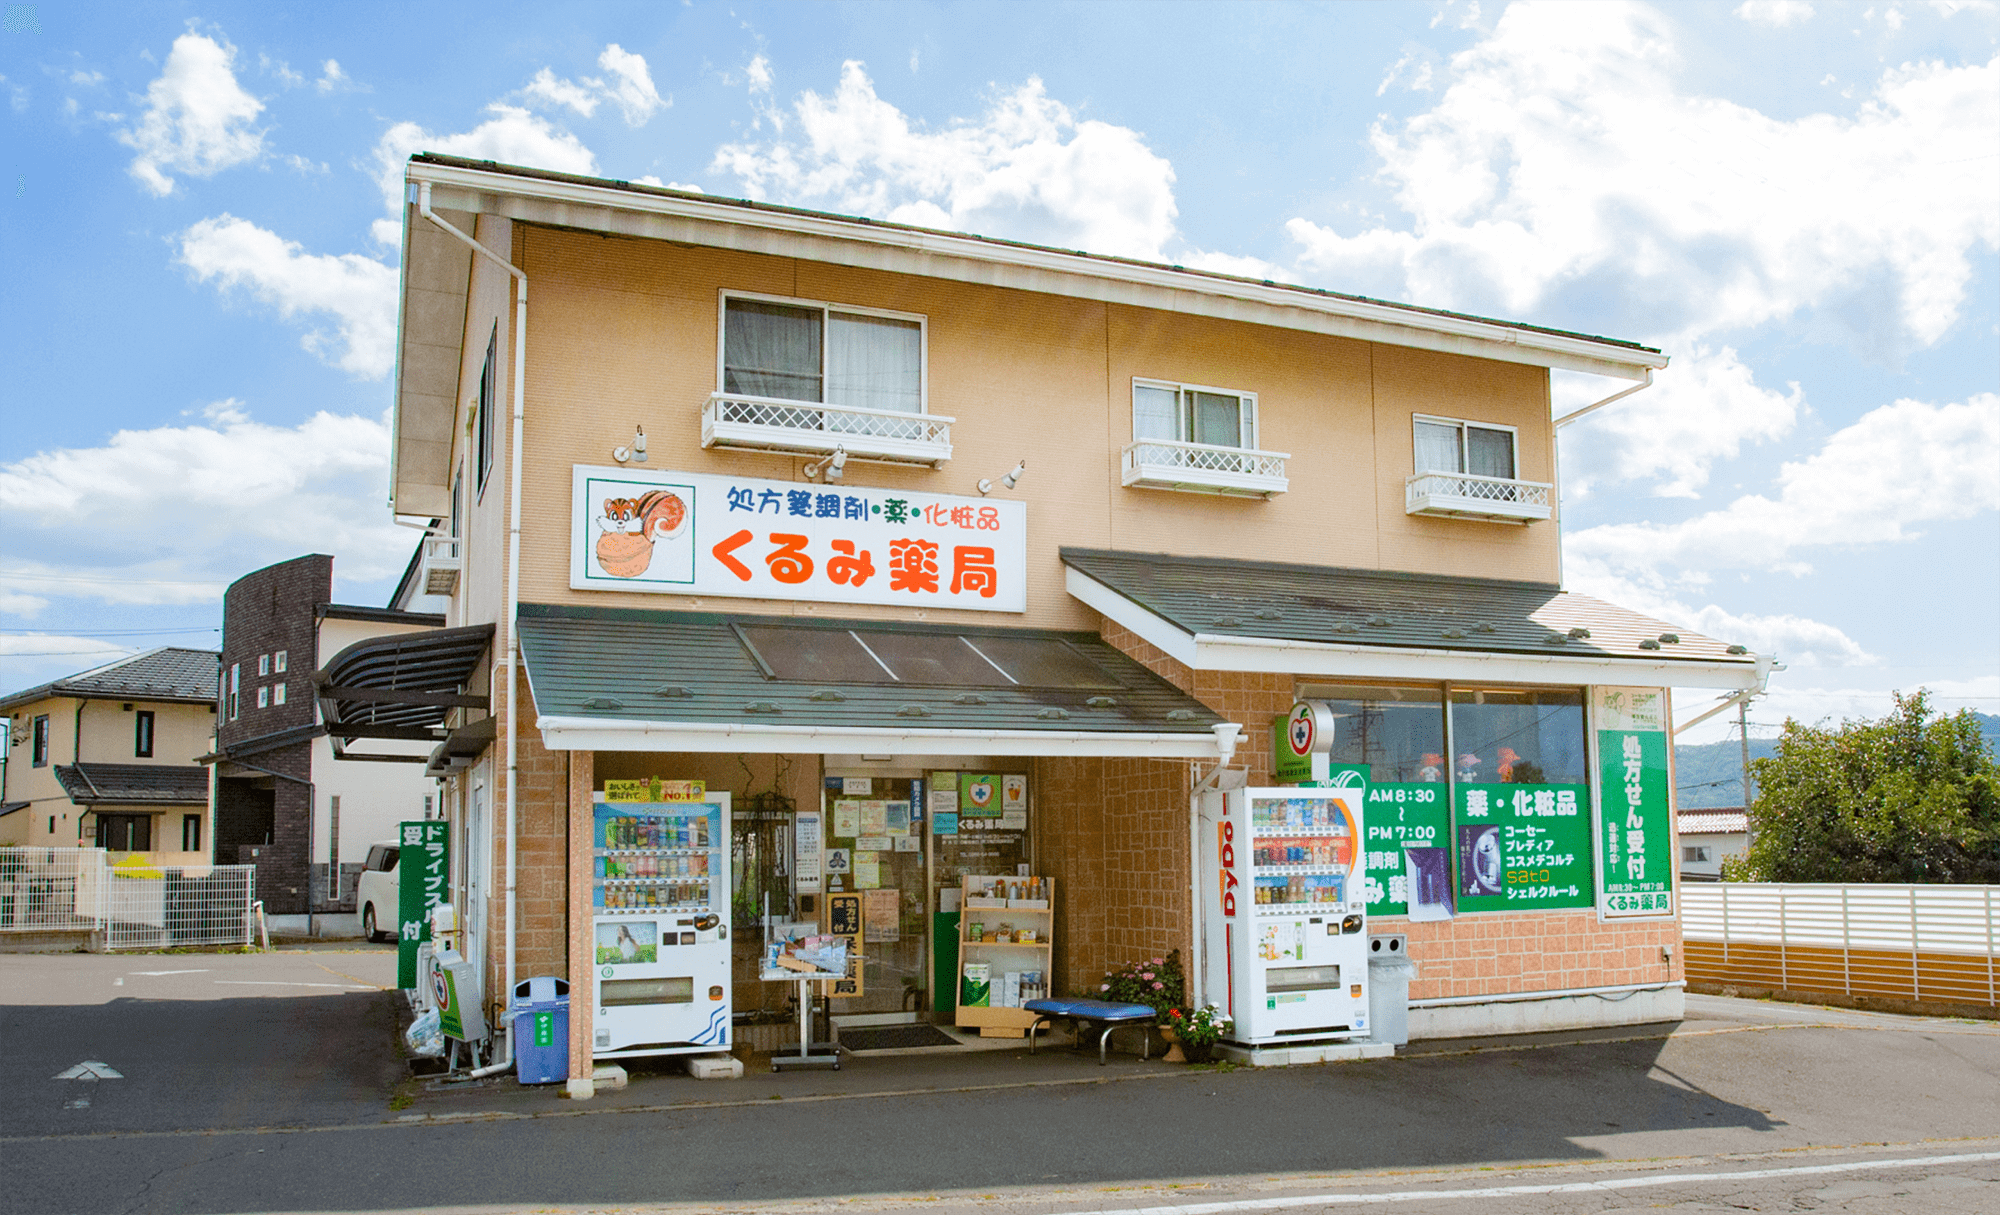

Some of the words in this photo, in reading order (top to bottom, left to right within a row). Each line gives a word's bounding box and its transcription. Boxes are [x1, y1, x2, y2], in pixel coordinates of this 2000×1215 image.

[712, 529, 997, 598] くるみ薬局
[1466, 789, 1577, 817] 薬・化粧品
[1623, 735, 1646, 880] 処方せん受付
[1505, 825, 1546, 837] コーセー
[1364, 851, 1399, 869] 調剤
[1506, 854, 1575, 867] コスメデコルテ
[1507, 869, 1549, 884] sato
[1507, 885, 1580, 900] シェルクルール
[1607, 894, 1668, 911] くるみ薬局
